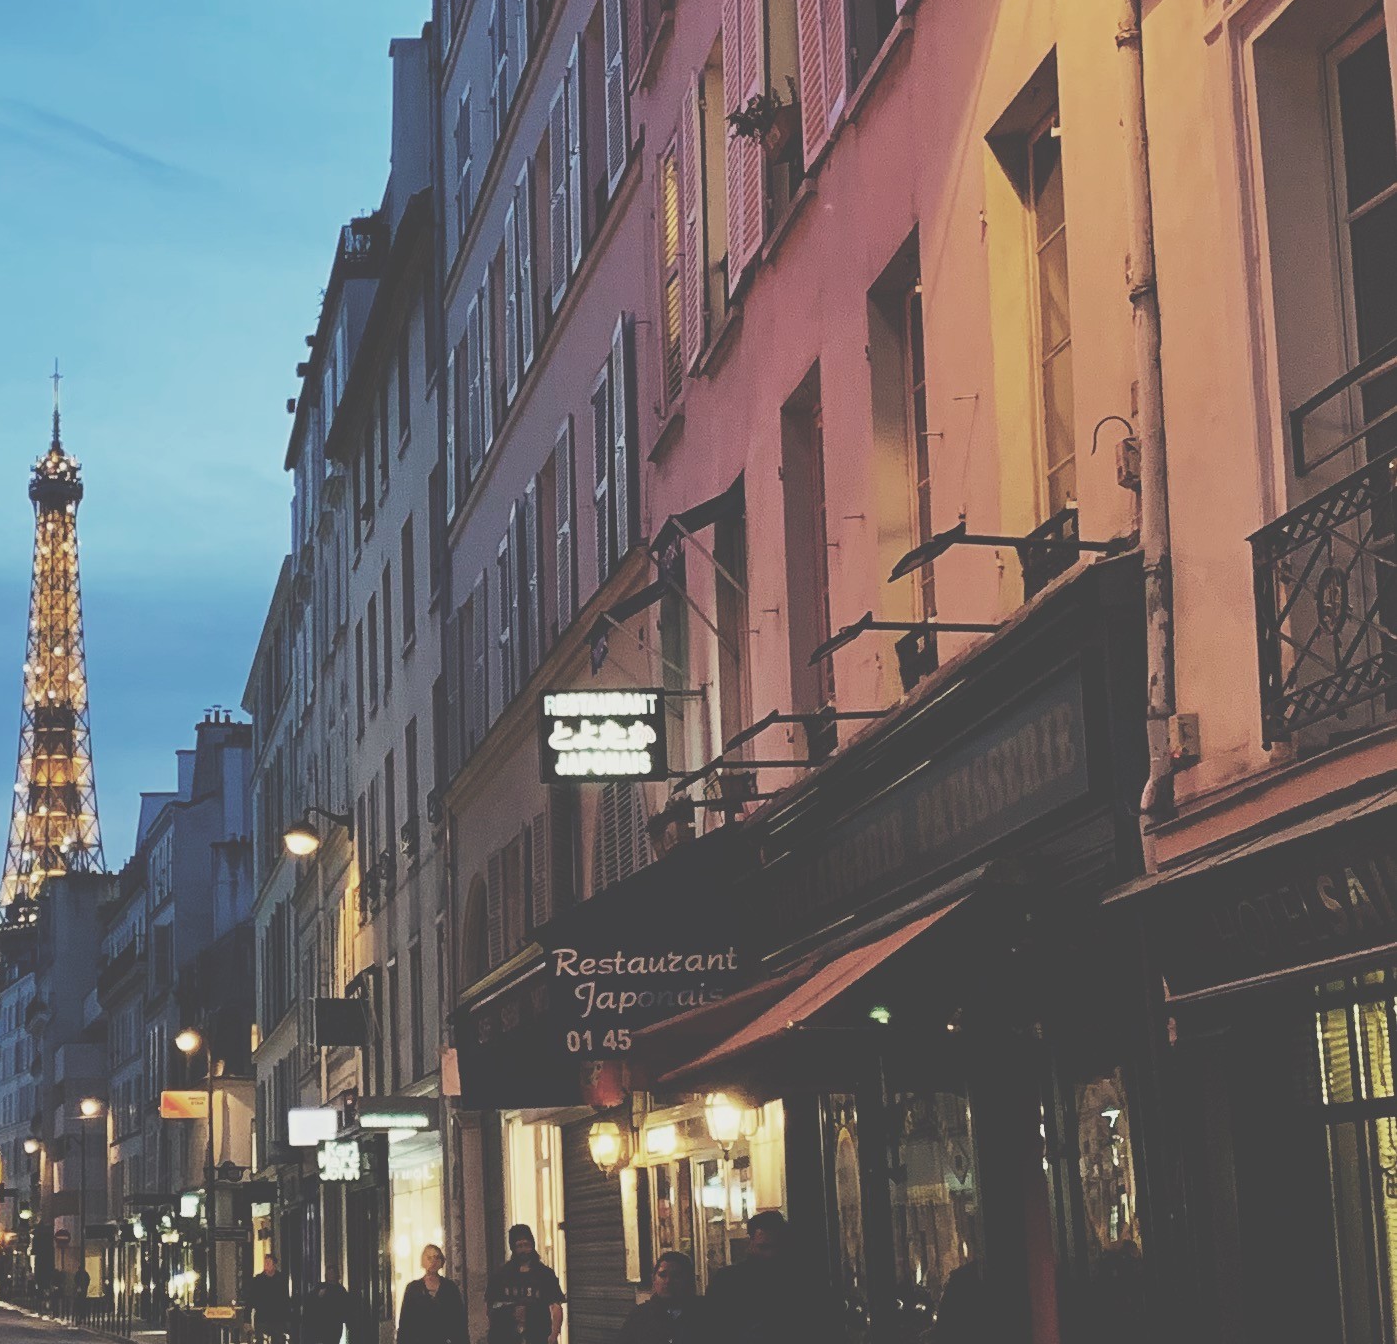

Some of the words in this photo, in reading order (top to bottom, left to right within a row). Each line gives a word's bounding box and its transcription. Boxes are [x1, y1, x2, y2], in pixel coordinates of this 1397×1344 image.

[543, 692, 658, 716] RESTAURANT
[554, 751, 652, 776] JAPONAIS
[551, 946, 739, 978] Restaurant
[566, 1029, 593, 1052] 01
[602, 1028, 632, 1051] 45
